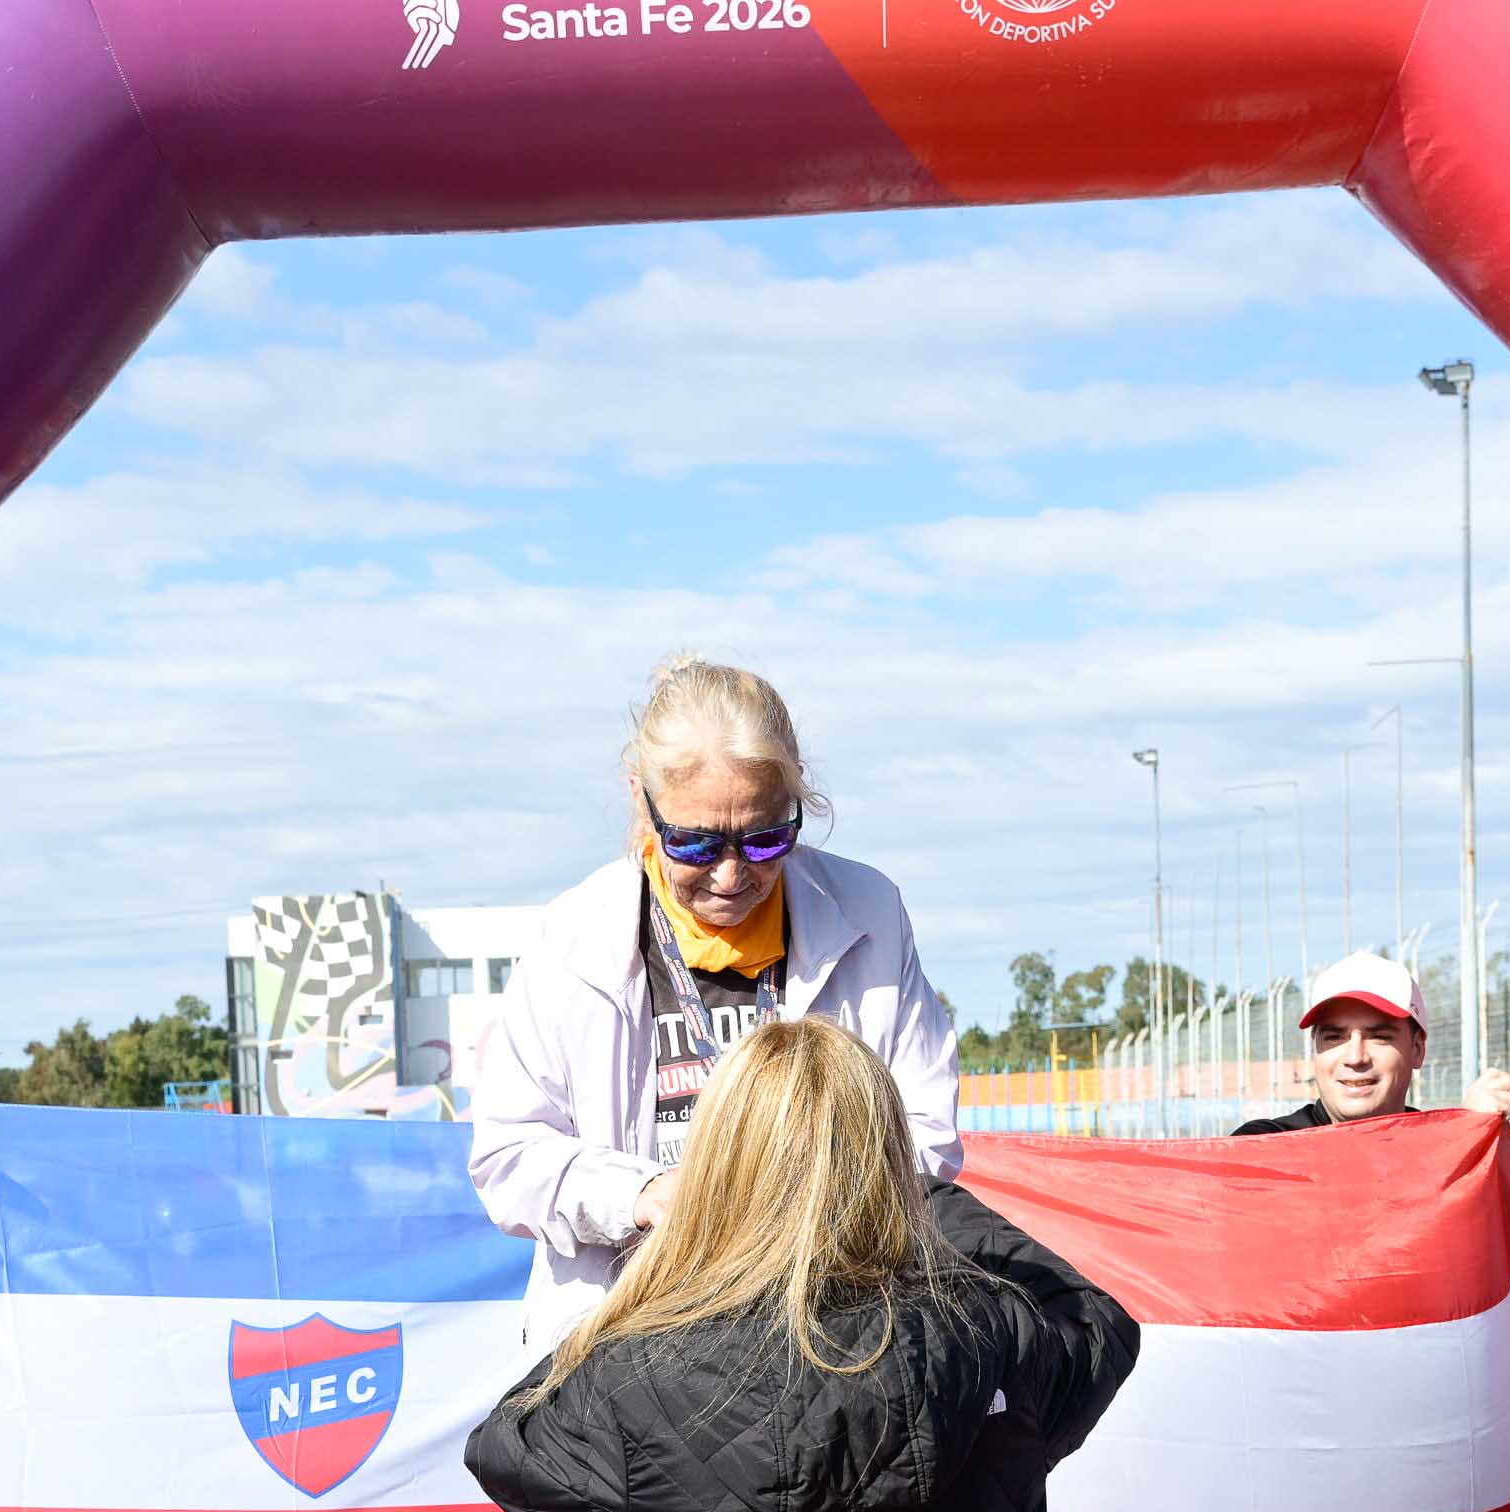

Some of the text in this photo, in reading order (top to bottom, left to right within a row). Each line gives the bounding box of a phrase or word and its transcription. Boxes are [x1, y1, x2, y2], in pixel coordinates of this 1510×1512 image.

[501, 0, 811, 41] Santa Fe 2026
[989, 14, 1092, 43] DEPORTIVA
[269, 1367, 377, 1423] NEC
